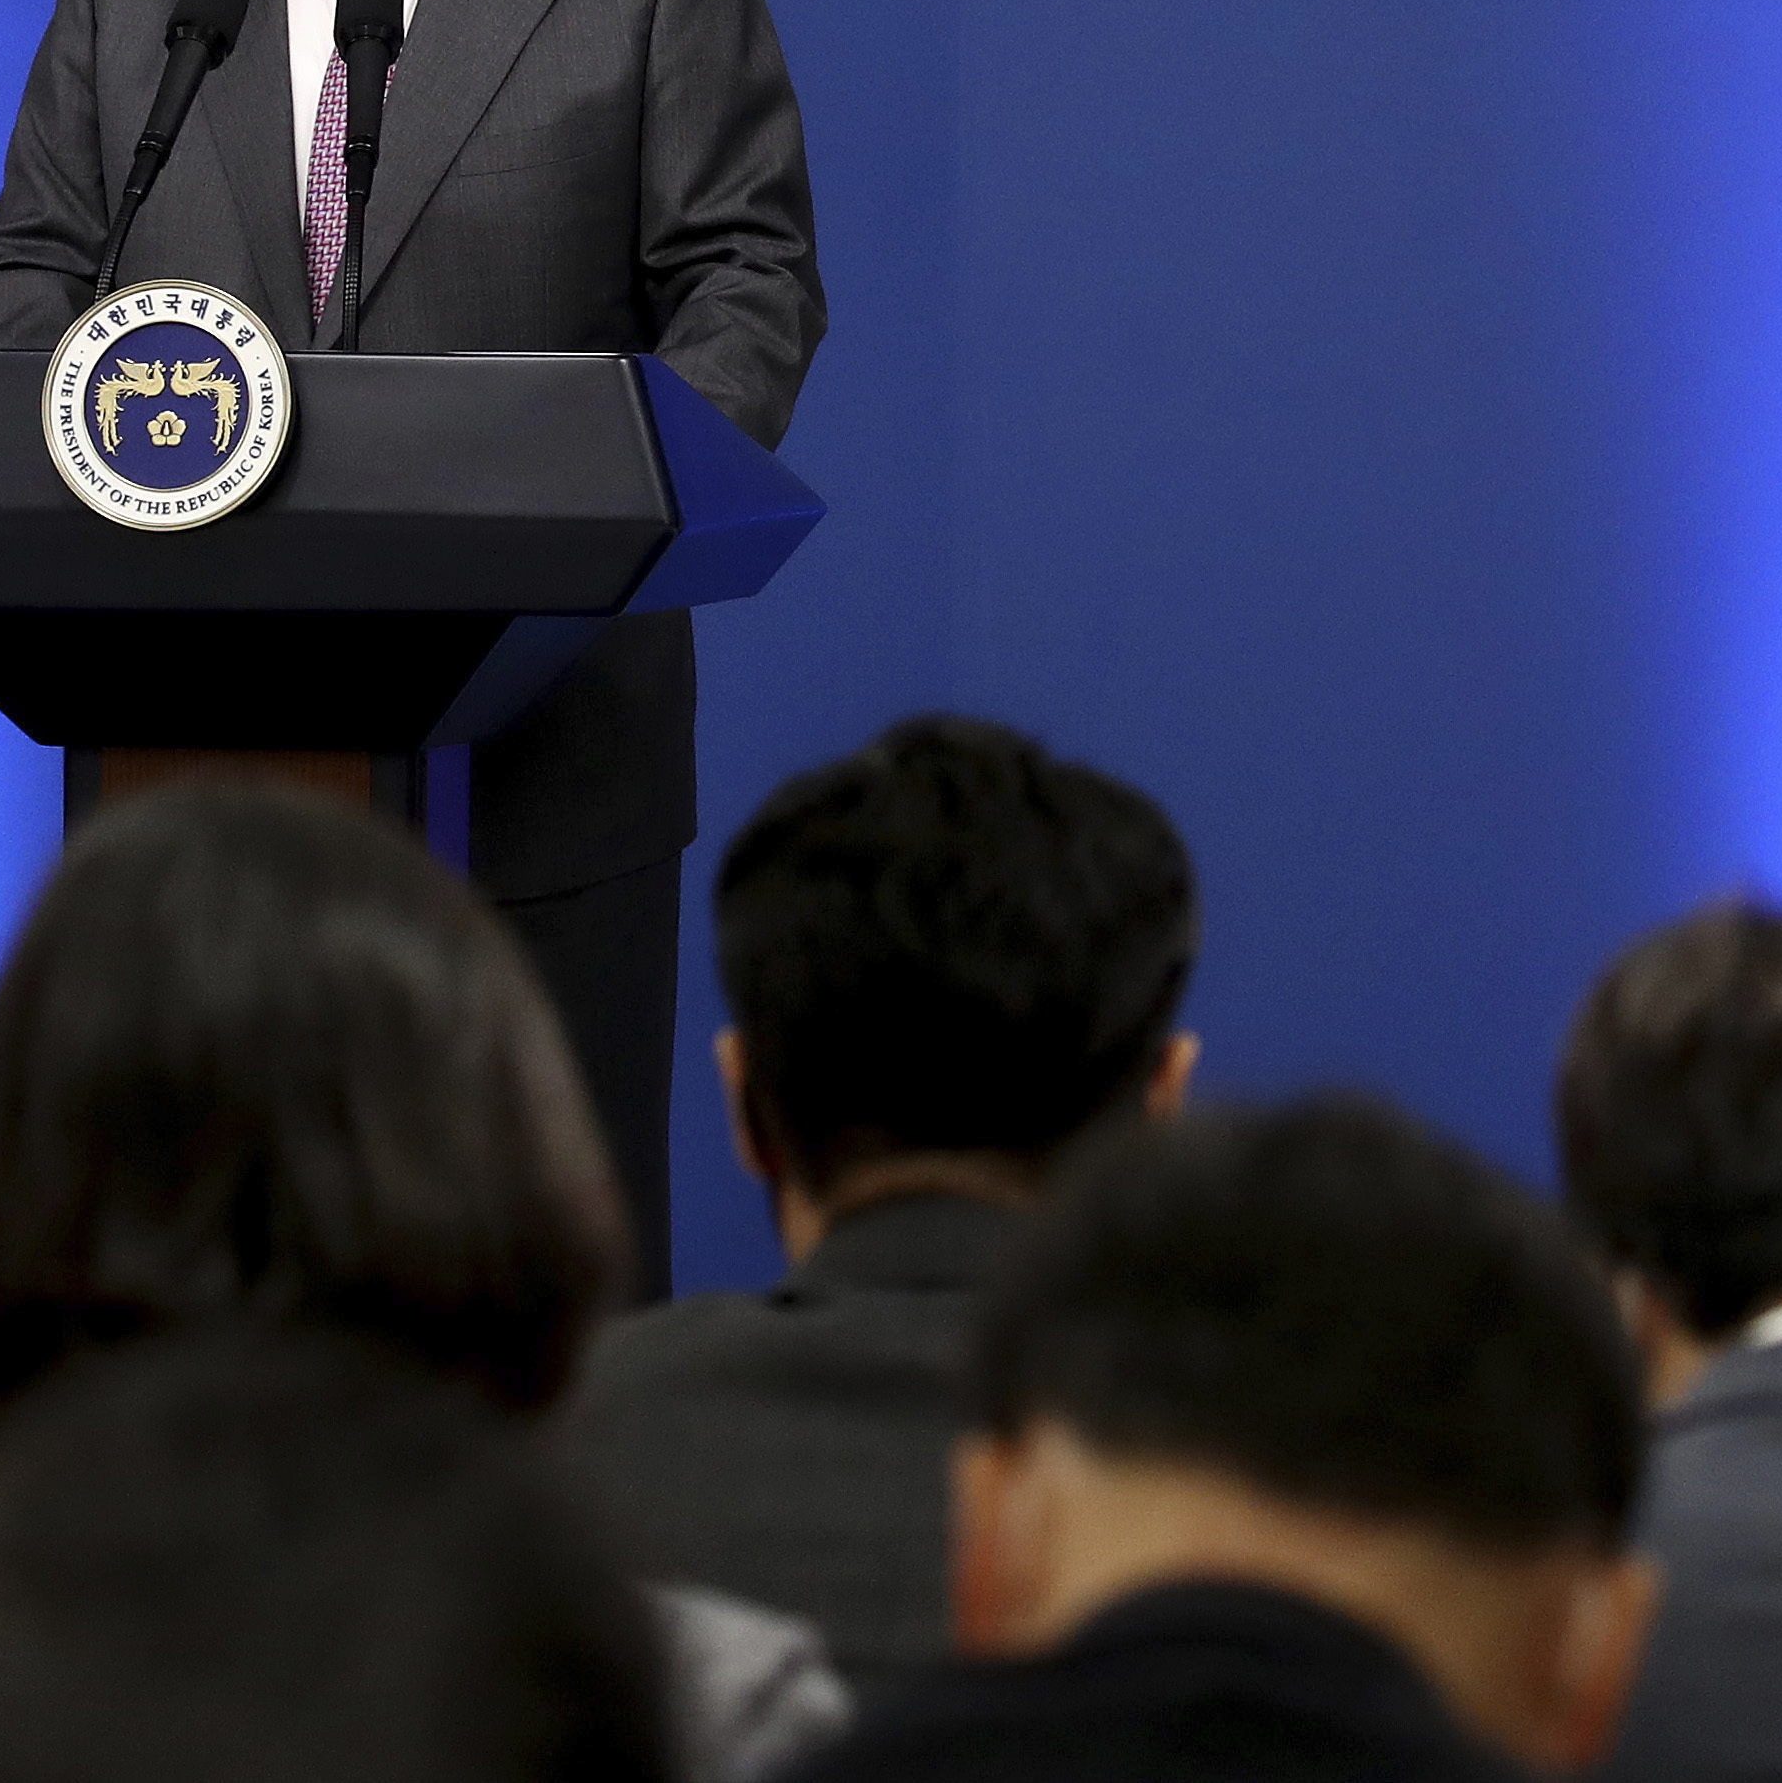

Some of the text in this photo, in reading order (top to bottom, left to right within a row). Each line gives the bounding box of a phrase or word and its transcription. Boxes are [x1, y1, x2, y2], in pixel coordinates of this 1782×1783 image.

[87, 293, 256, 349] 대한민국대통령
[59, 360, 275, 515] THE PRESIDENT OF THE REPUBLIC OF KOREA
